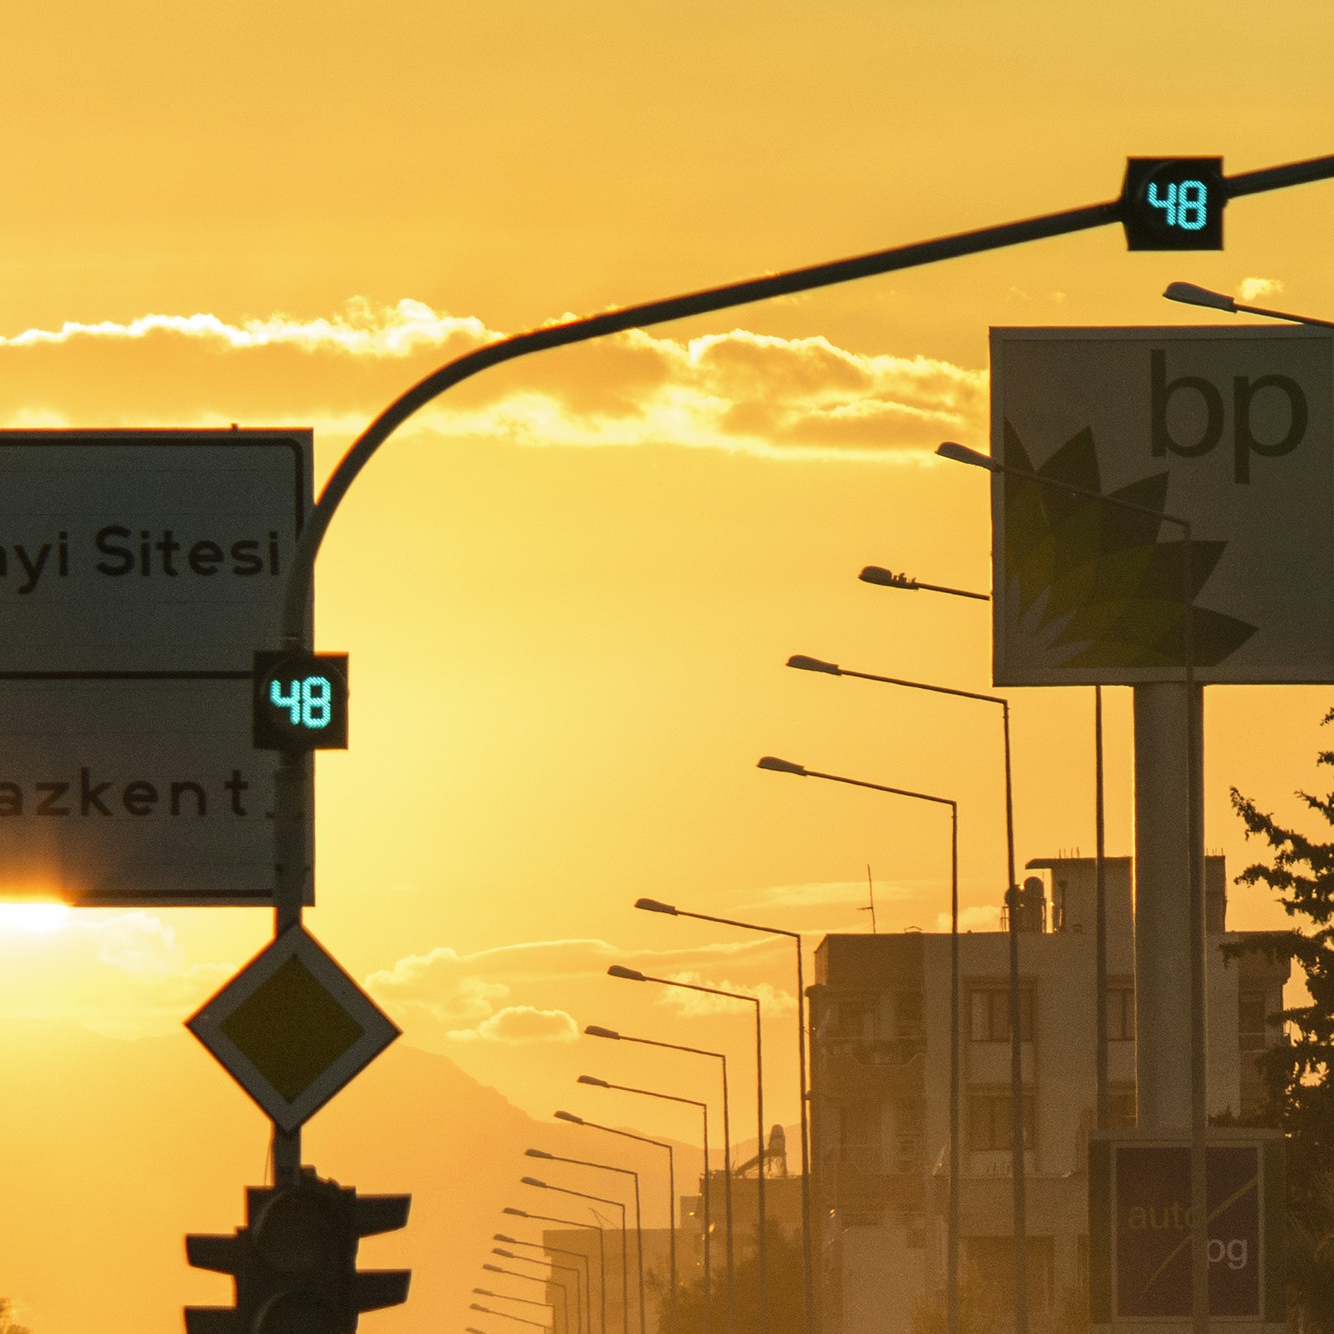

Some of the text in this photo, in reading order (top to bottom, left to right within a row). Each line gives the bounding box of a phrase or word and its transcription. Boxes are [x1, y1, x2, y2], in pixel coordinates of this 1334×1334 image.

[1147, 179, 1208, 232] 48
[1150, 348, 1308, 485] bp
[96, 525, 280, 579] Sitesi
[269, 676, 332, 729] 48
